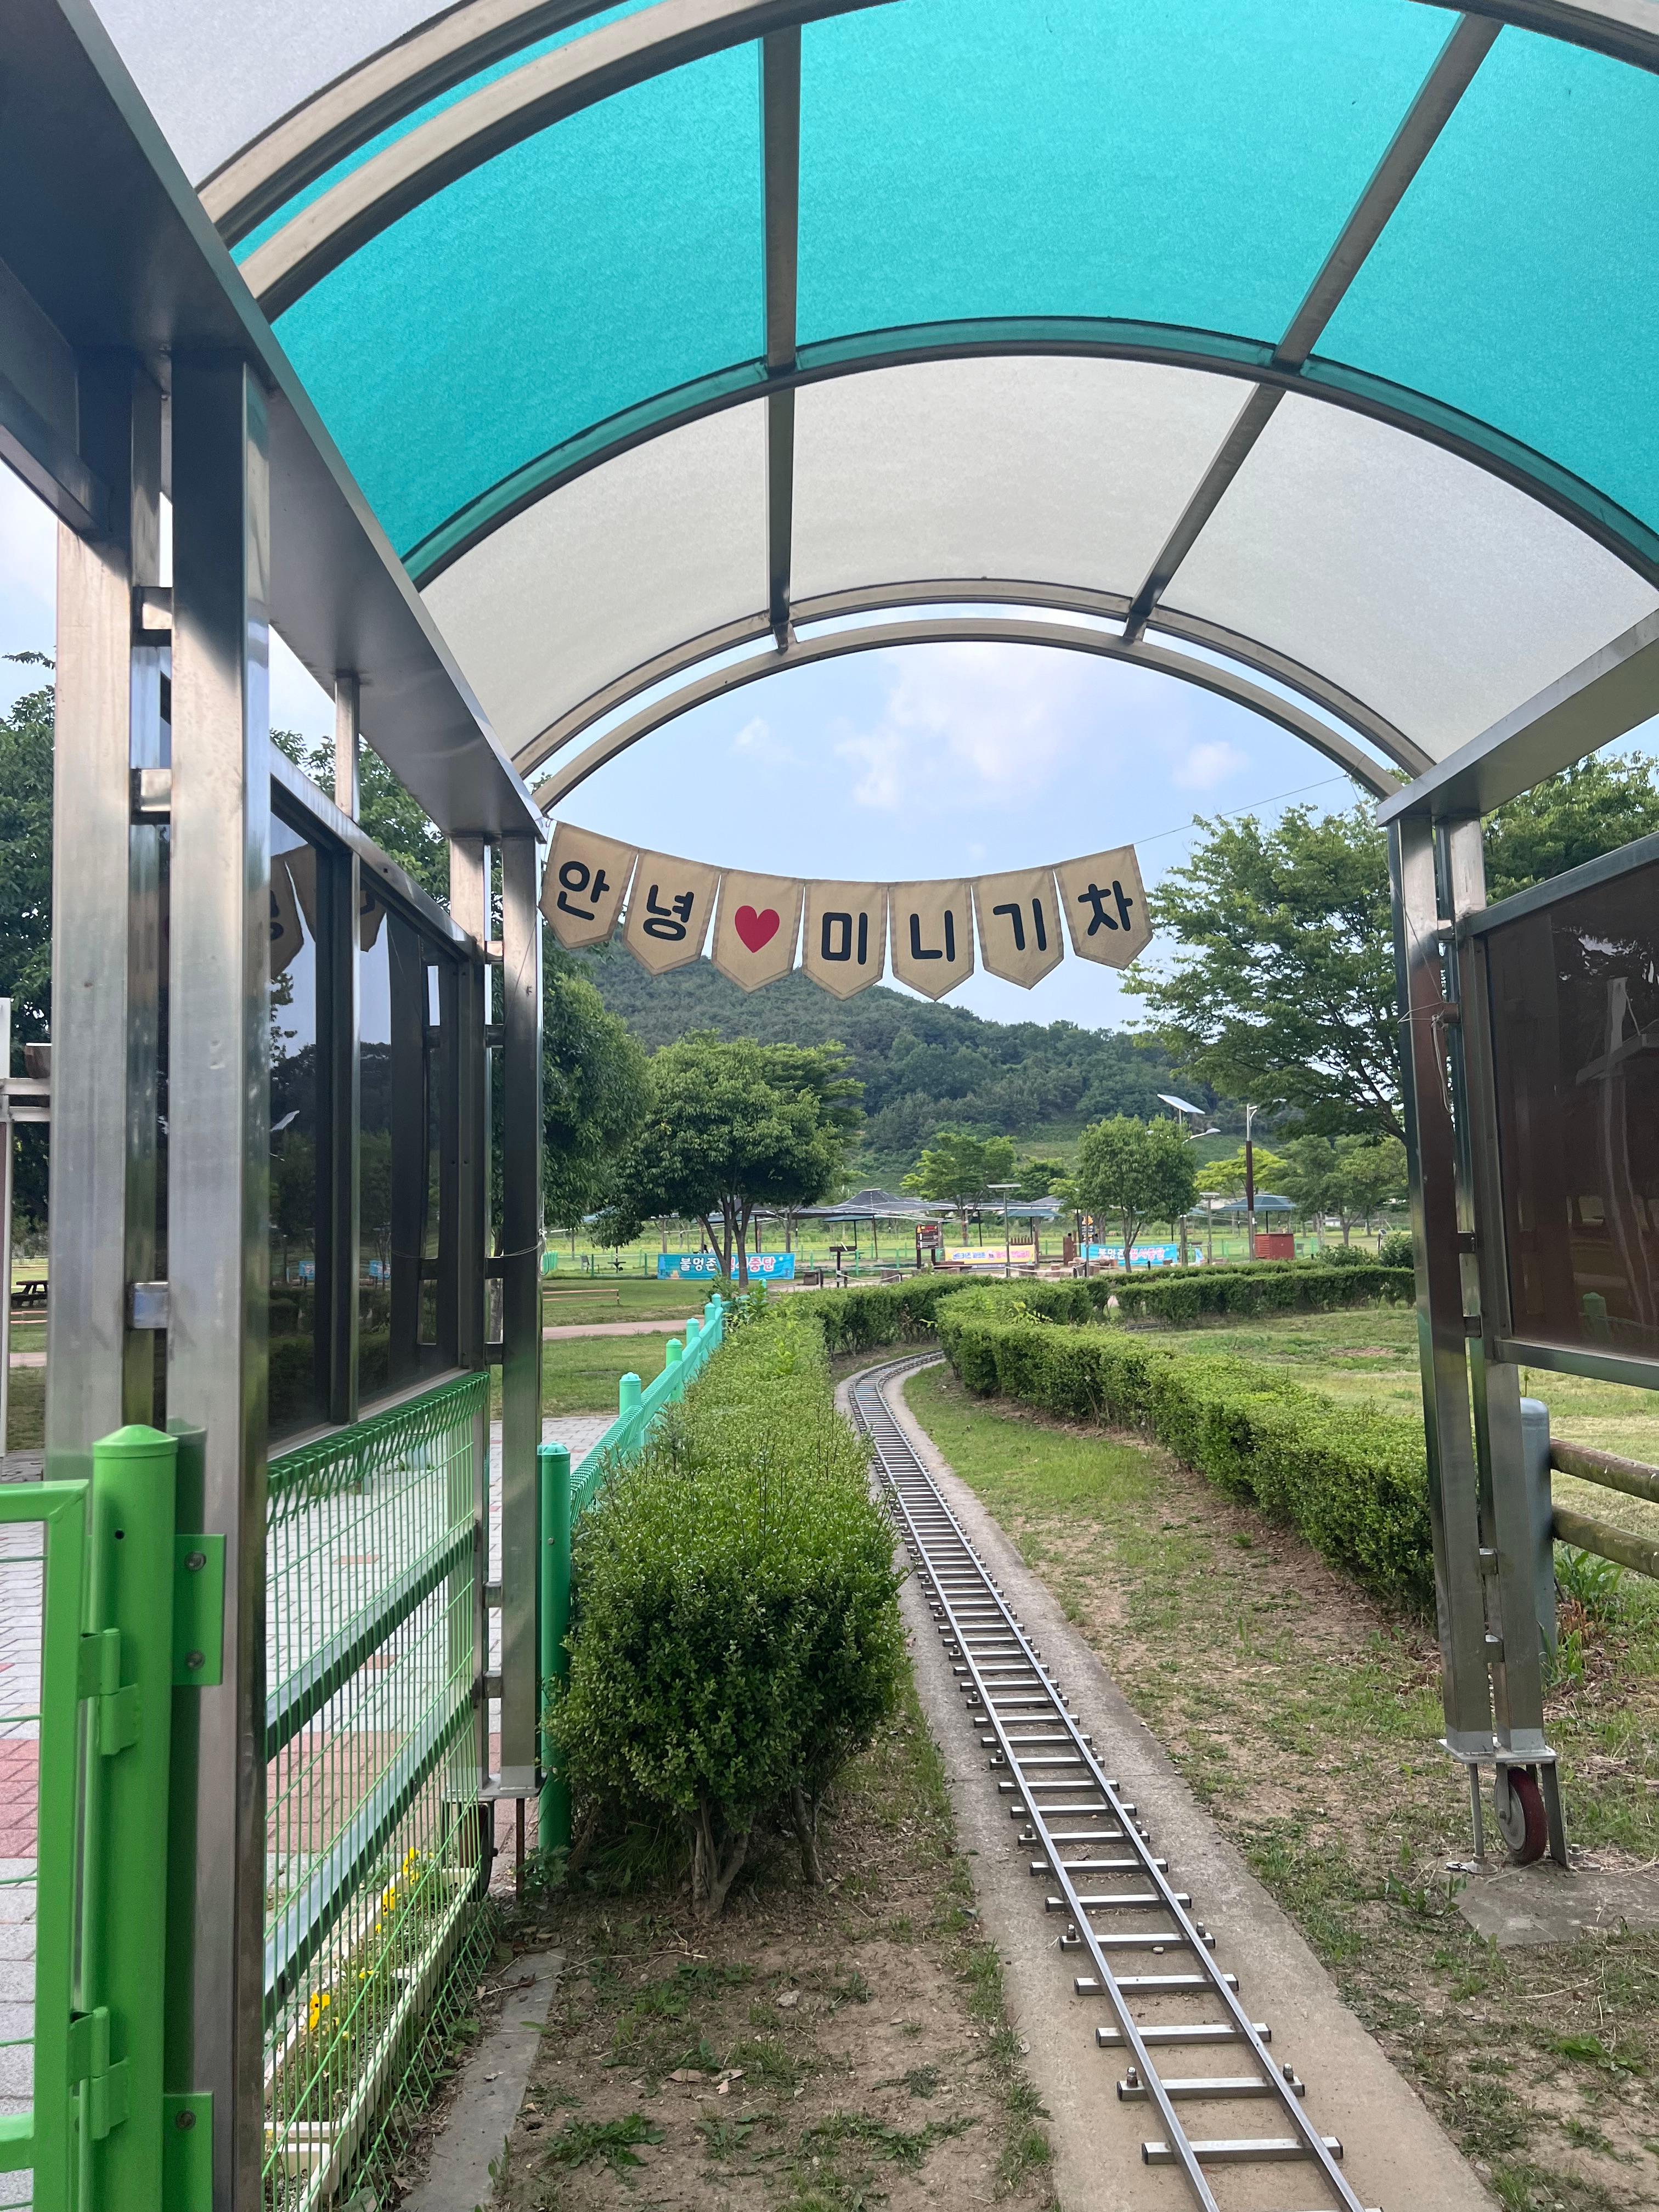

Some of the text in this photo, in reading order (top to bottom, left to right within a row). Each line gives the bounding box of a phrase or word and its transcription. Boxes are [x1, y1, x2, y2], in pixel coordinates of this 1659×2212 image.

[557, 860, 1133, 966] 안녕 미니기차
[680, 1257, 718, 1272] 불멍존
